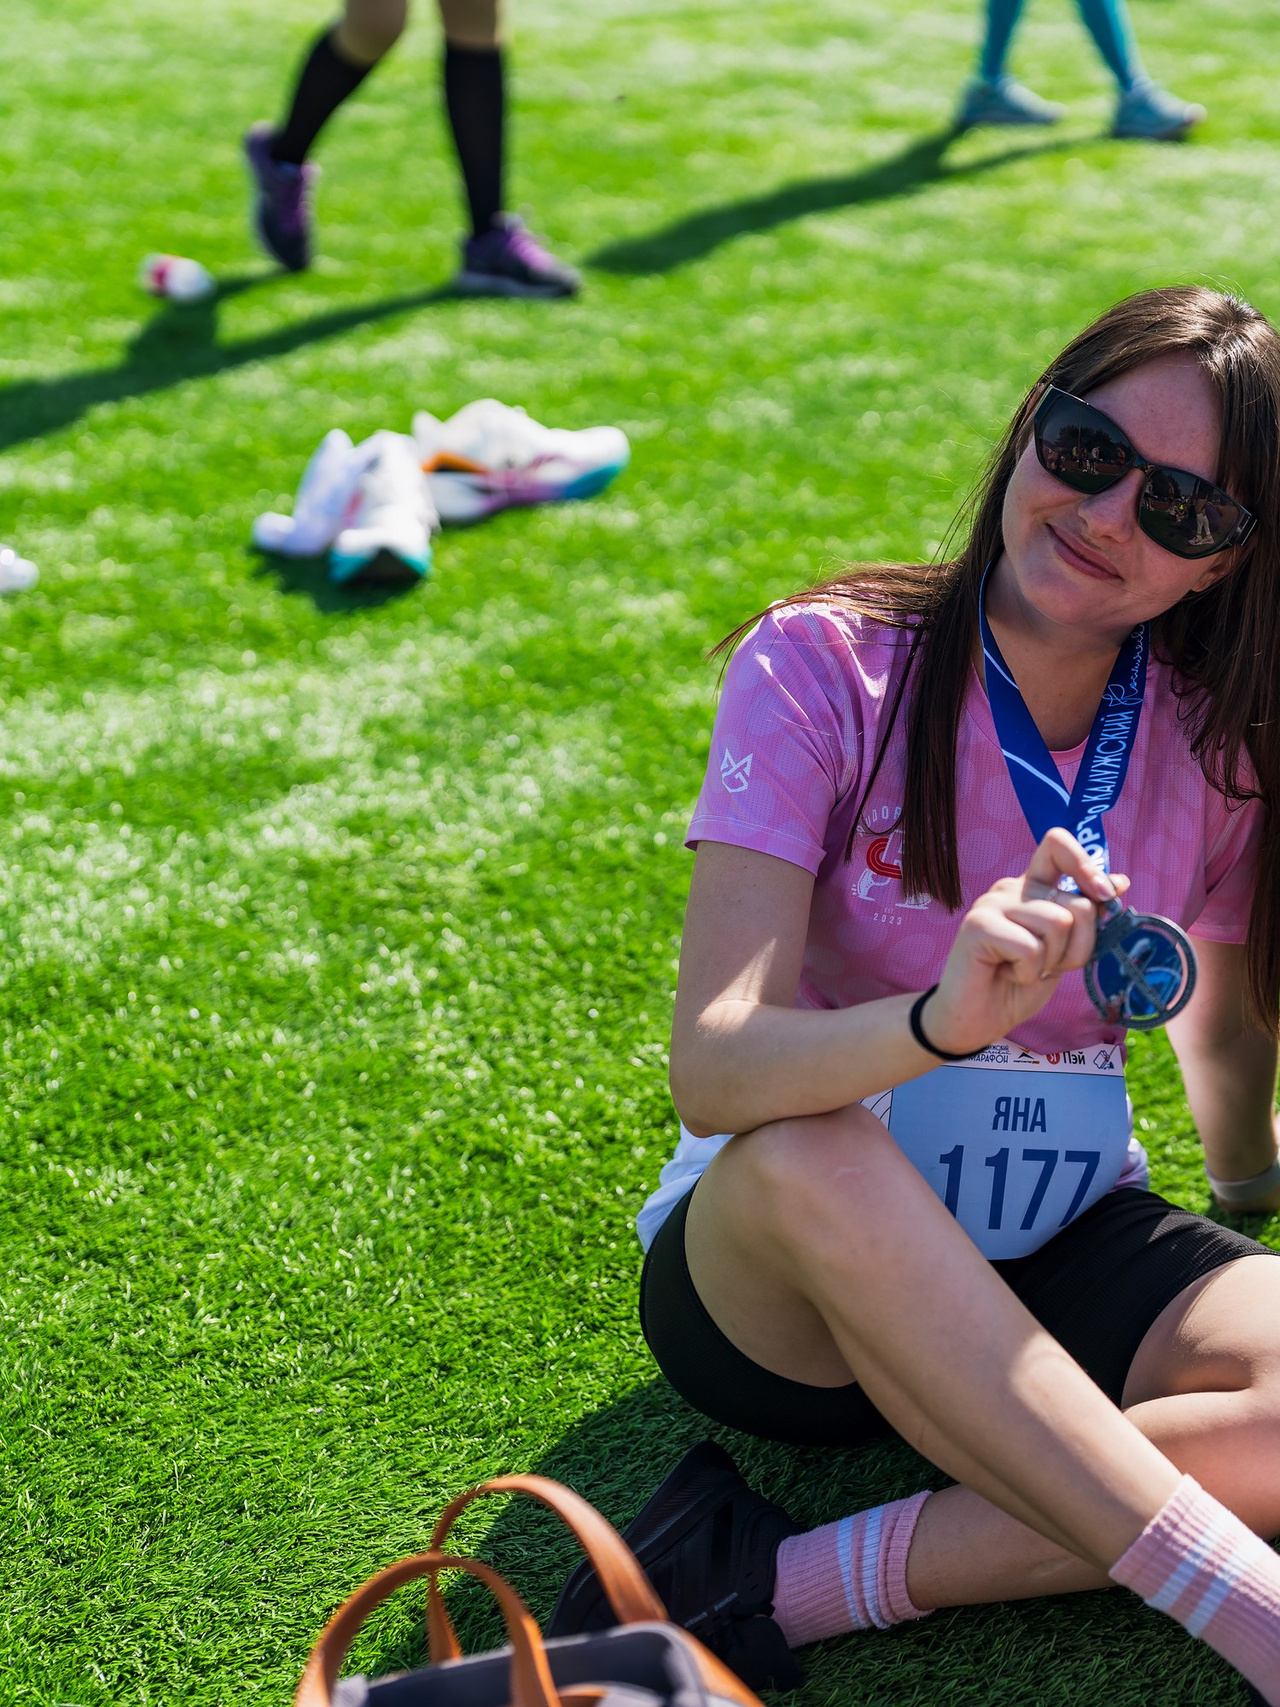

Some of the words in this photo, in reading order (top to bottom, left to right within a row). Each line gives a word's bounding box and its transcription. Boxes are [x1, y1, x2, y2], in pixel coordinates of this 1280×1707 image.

[1082, 710, 1135, 802] КАЛУЖСКИЙ
[856, 805, 902, 837] RUDOR
[873, 912, 902, 925] 2023
[1063, 1051, 1086, 1065] Пэй
[992, 1096, 1047, 1133] ЯНА
[939, 1145, 1101, 1230] 1177
